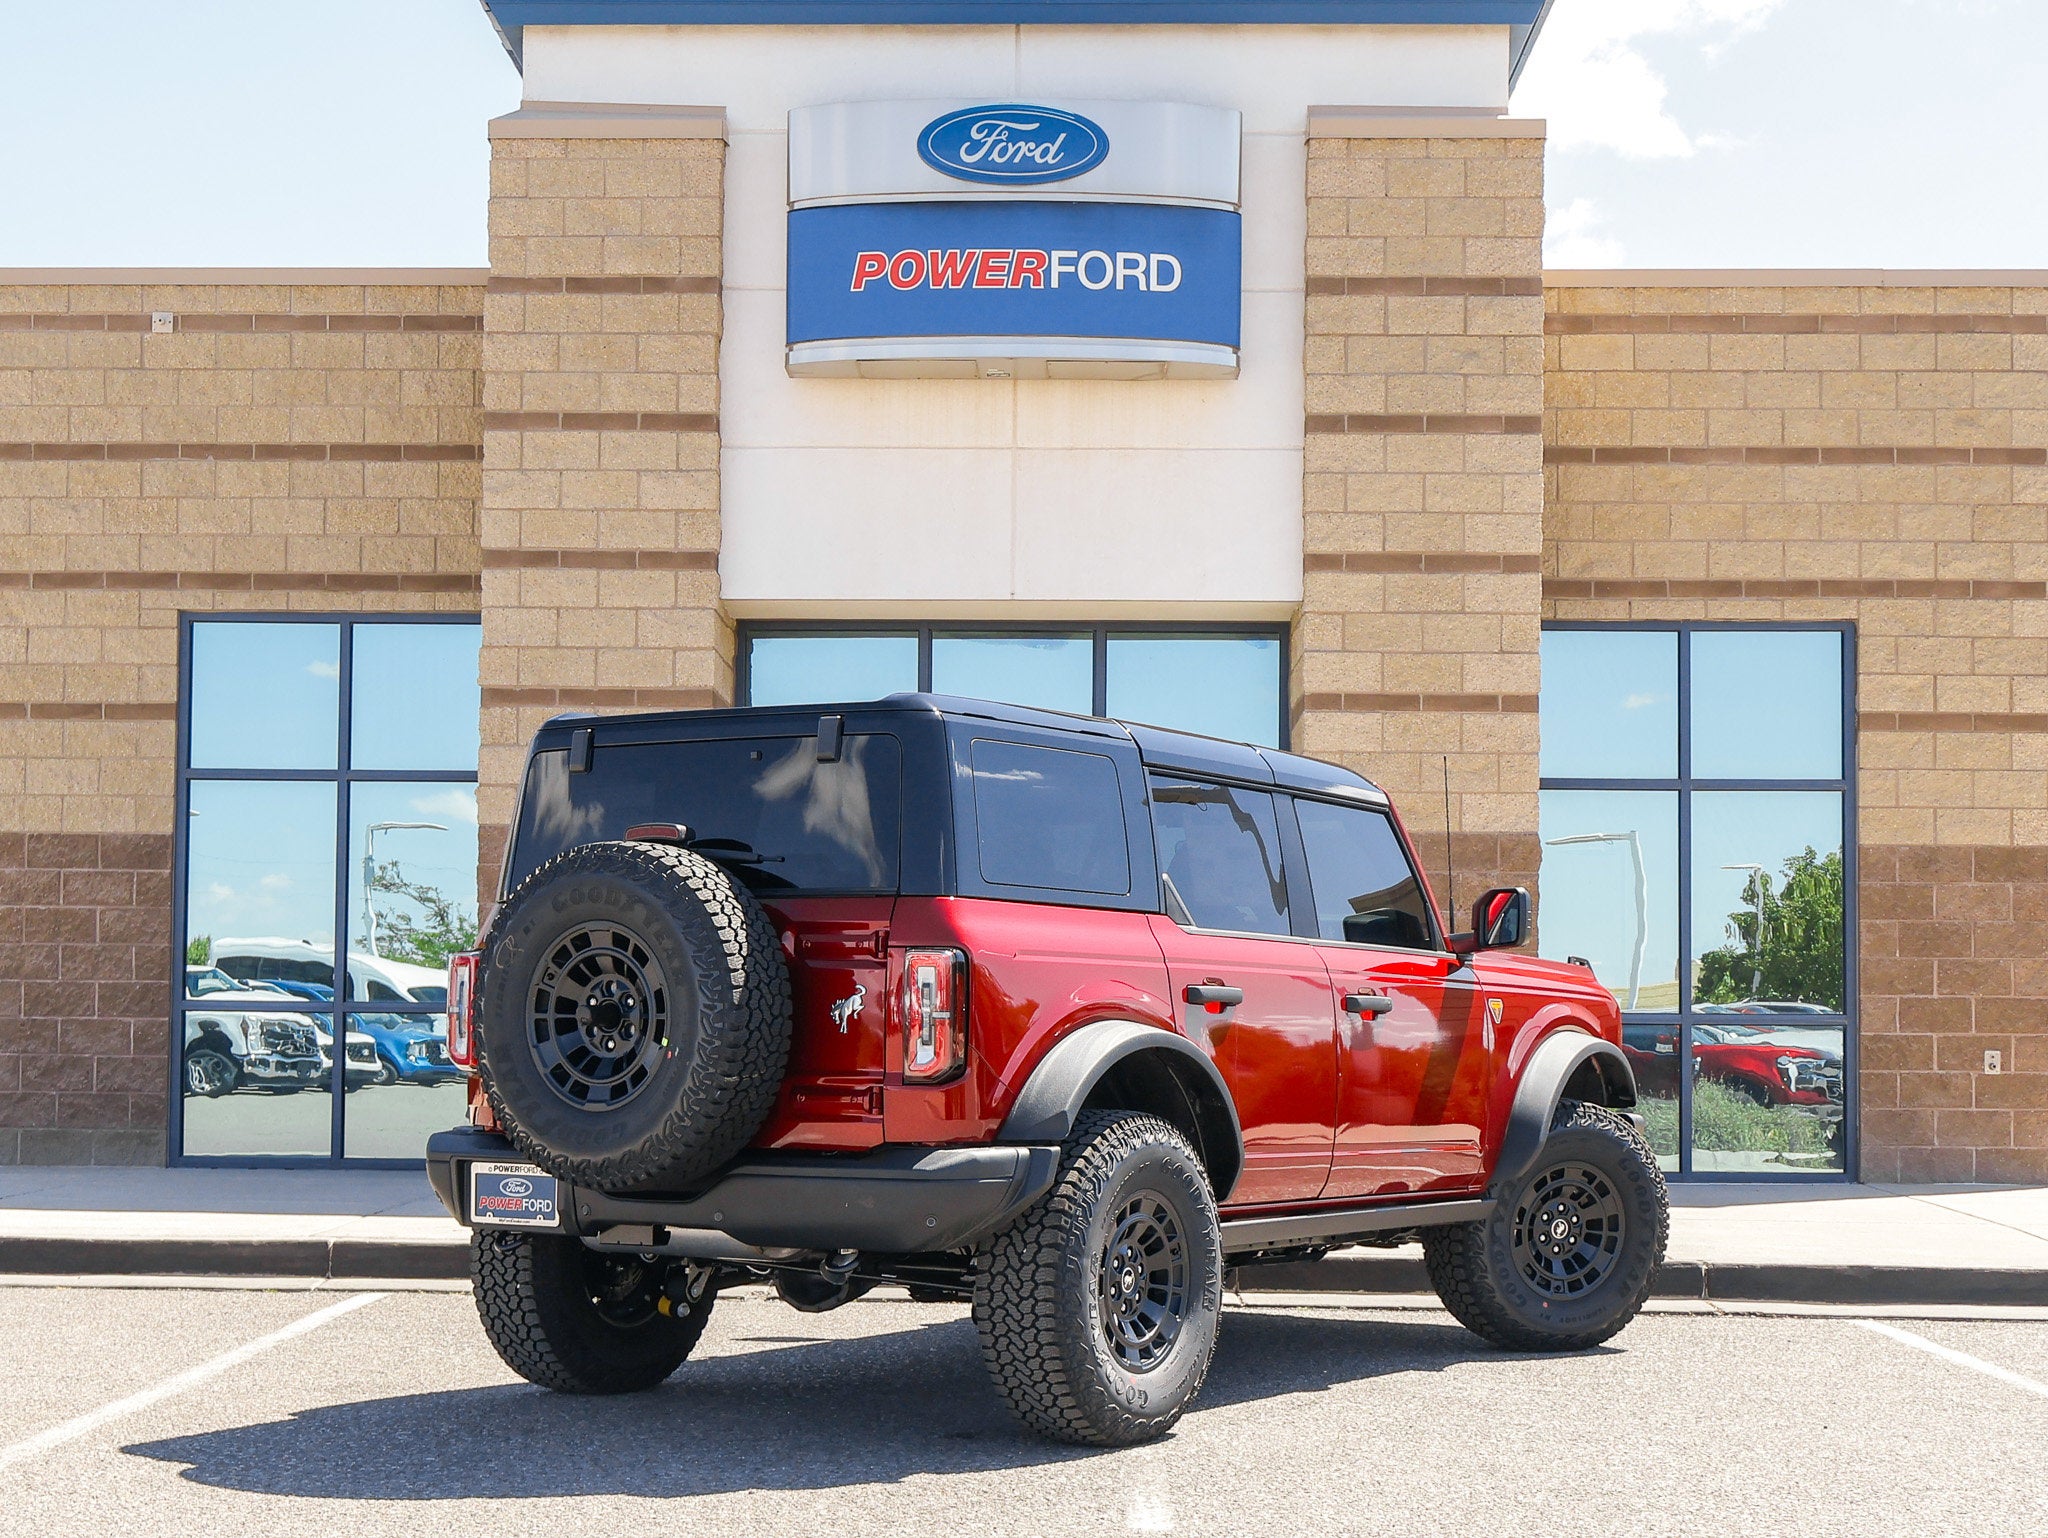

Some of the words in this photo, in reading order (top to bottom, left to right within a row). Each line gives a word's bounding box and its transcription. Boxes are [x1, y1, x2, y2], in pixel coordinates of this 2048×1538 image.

[959, 119, 1067, 166] Ford
[850, 248, 1183, 293] POWERFORD
[493, 1164, 539, 1174] POWERFORD
[505, 1180, 526, 1193] Ford
[479, 1196, 553, 1213] POWERFORD
